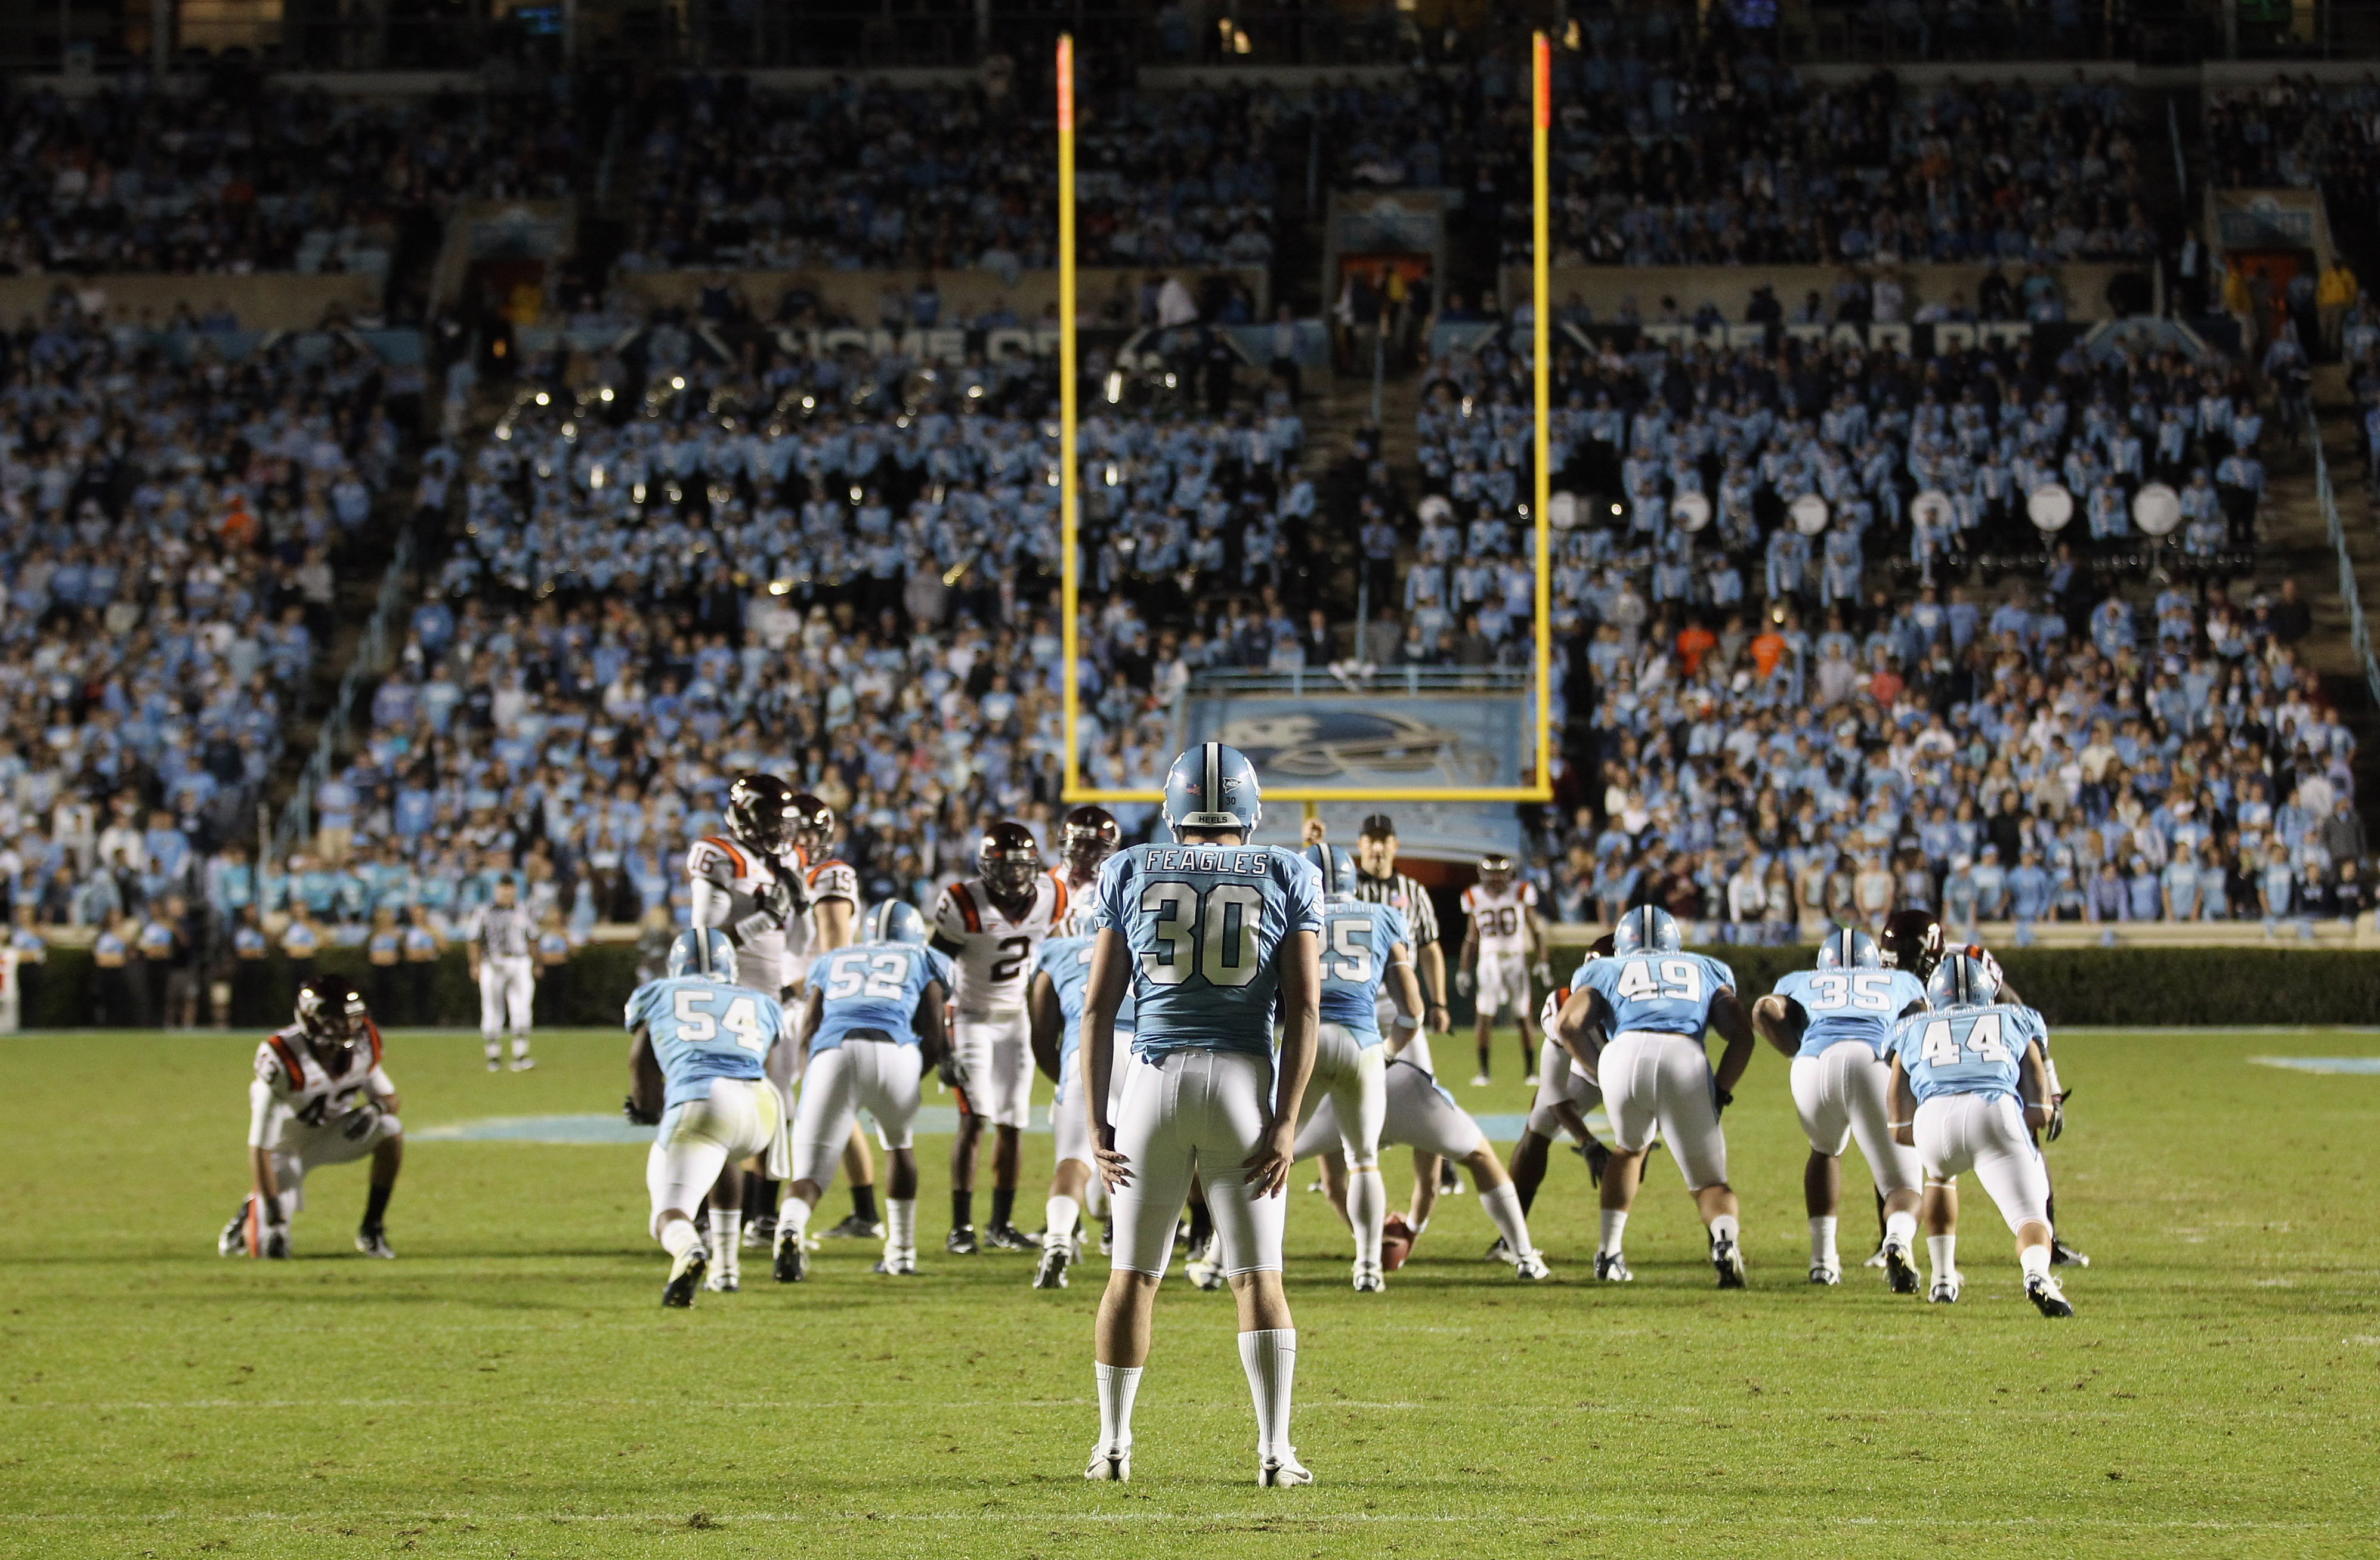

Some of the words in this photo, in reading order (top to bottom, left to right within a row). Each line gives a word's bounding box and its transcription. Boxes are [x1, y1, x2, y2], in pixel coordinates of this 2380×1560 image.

[1226, 797, 1236, 805] 30
[1145, 850, 1269, 875] FEAGLES
[1139, 881, 1265, 986] 30
[825, 952, 910, 1001] 52
[990, 935, 1030, 983] 2
[1617, 959, 1702, 1003] 49
[1810, 973, 1892, 1011] 35
[673, 991, 764, 1054] 54
[1920, 1013, 2010, 1068] 44
